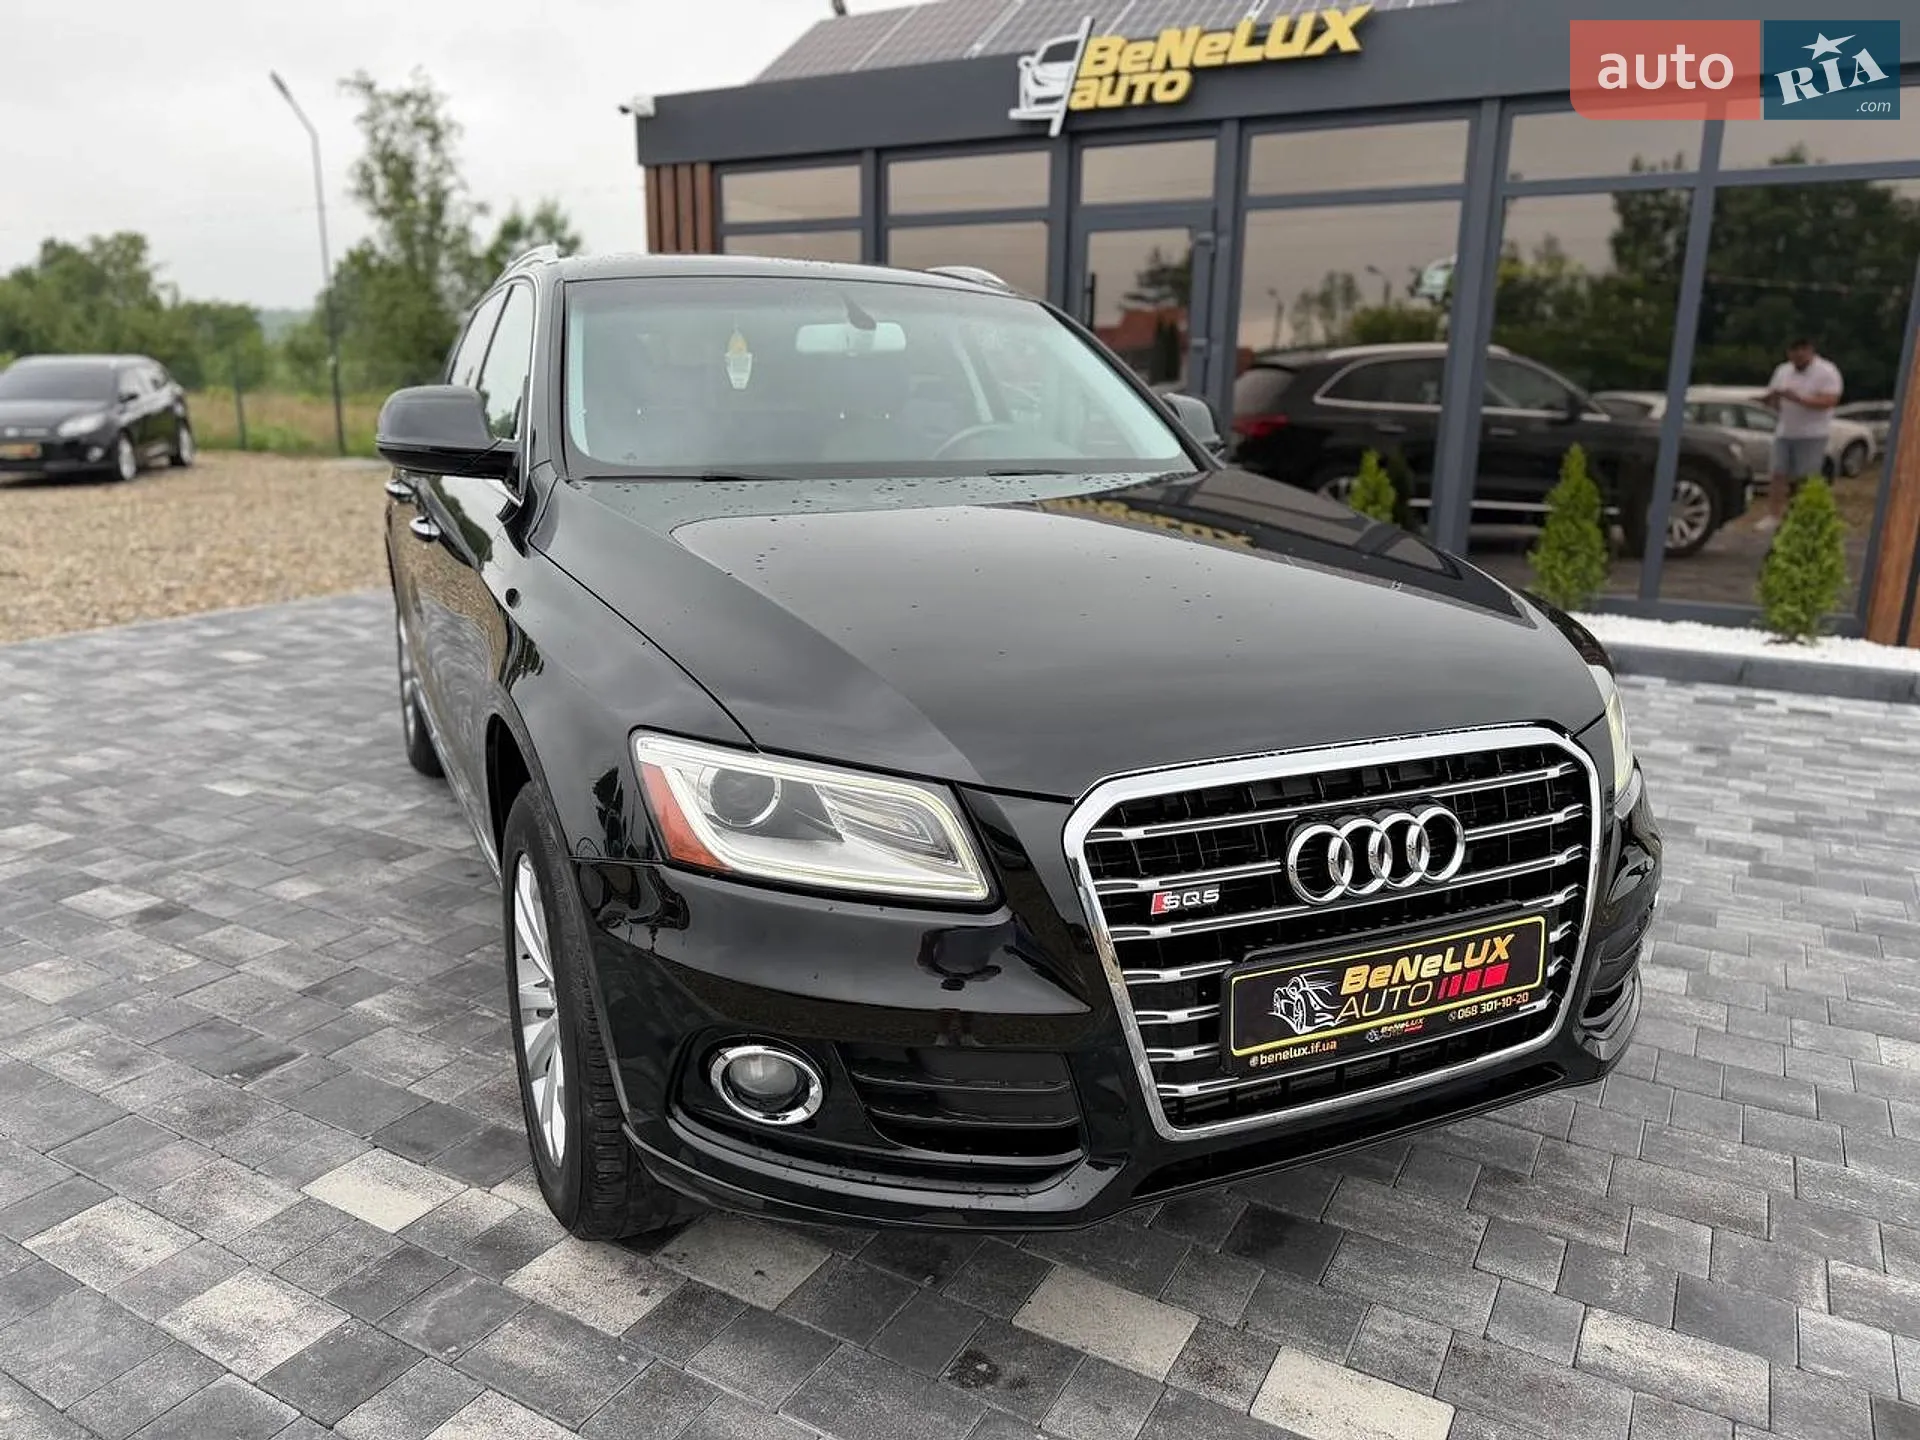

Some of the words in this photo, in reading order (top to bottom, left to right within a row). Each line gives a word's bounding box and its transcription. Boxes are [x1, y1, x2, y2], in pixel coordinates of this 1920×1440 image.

[1163, 888, 1220, 910] SQ5
[1340, 933, 1515, 996] BeNeLUX
[1335, 980, 1433, 1024] AUTO
[1457, 1003, 1478, 1020] 068
[1480, 991, 1530, 1014] 301-10-20
